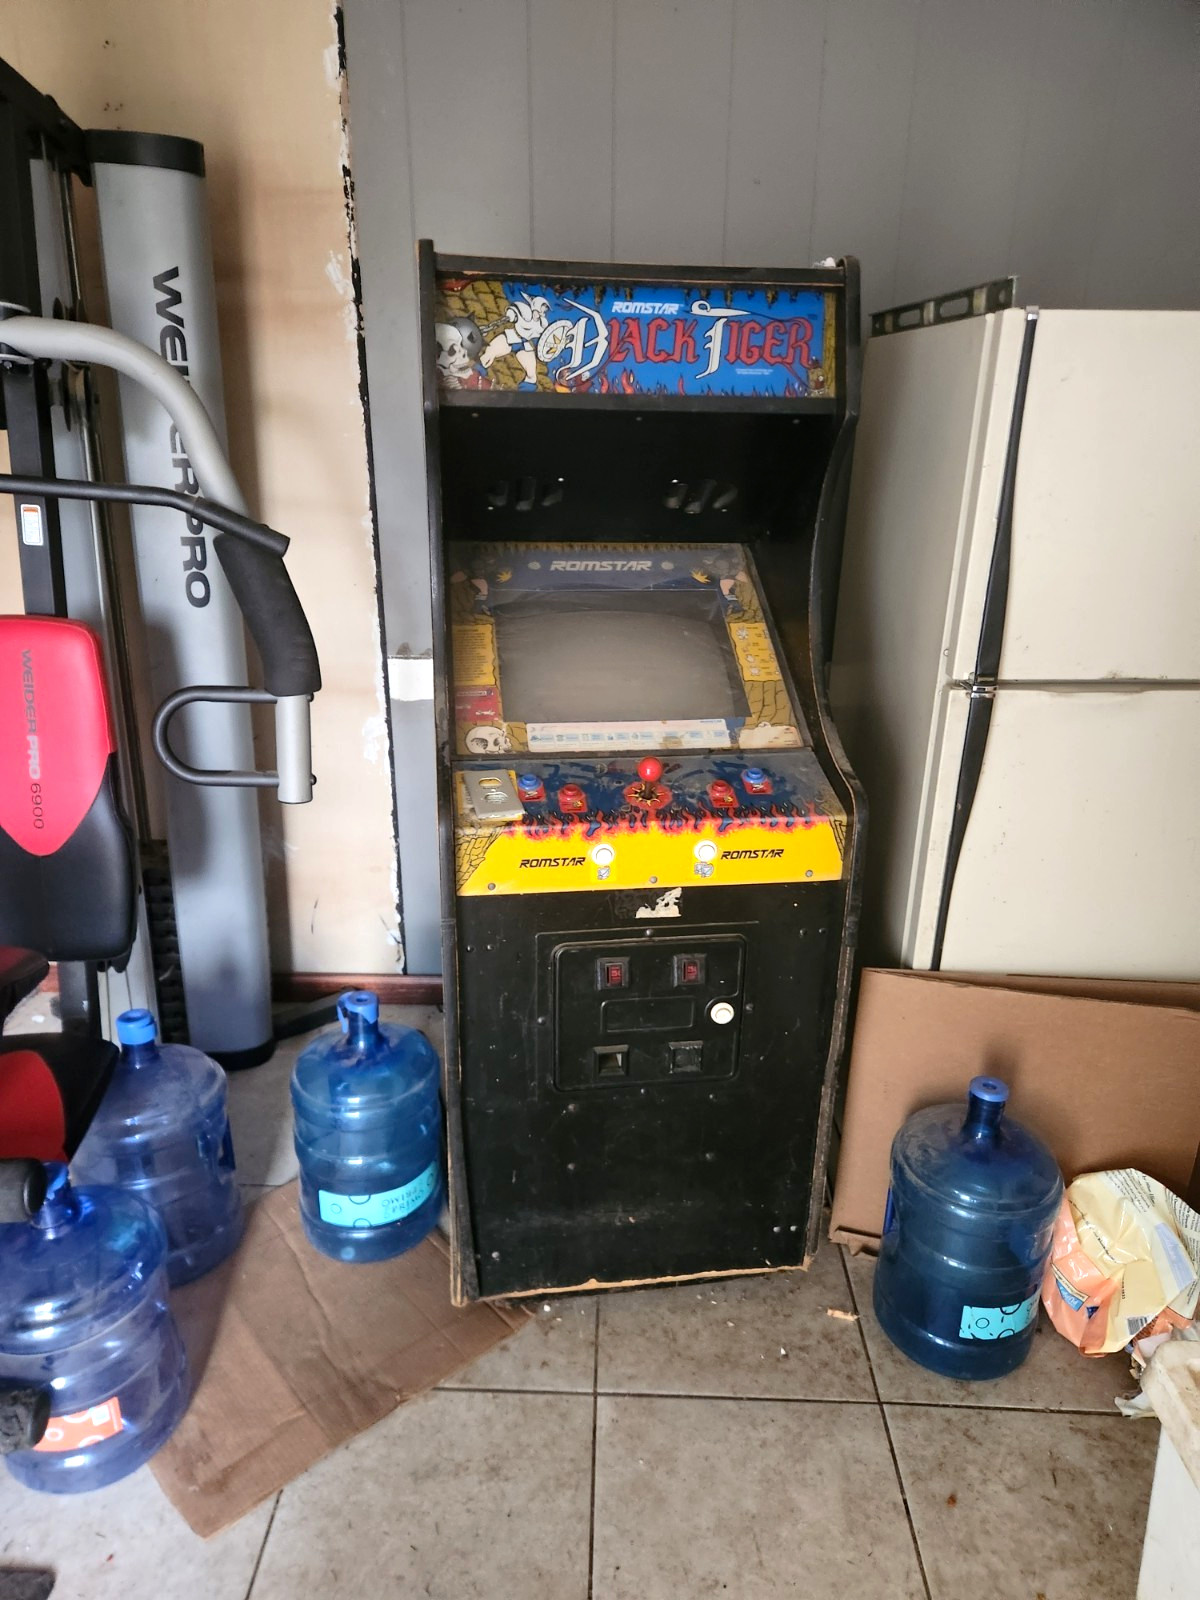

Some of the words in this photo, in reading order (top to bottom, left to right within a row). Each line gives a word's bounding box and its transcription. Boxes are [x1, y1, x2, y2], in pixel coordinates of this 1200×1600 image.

[611, 301, 680, 315] ROMSTAR
[557, 297, 699, 380] BLACK
[690, 299, 813, 379] TIGER
[153, 266, 201, 498] WEER
[550, 560, 652, 572] ROMSTAR
[22, 649, 37, 733] WEIDER
[27, 735, 40, 779] PRO
[31, 782, 44, 829] 6900
[519, 856, 586, 869] ROMSTAR
[721, 848, 784, 860] ROMSTAR
